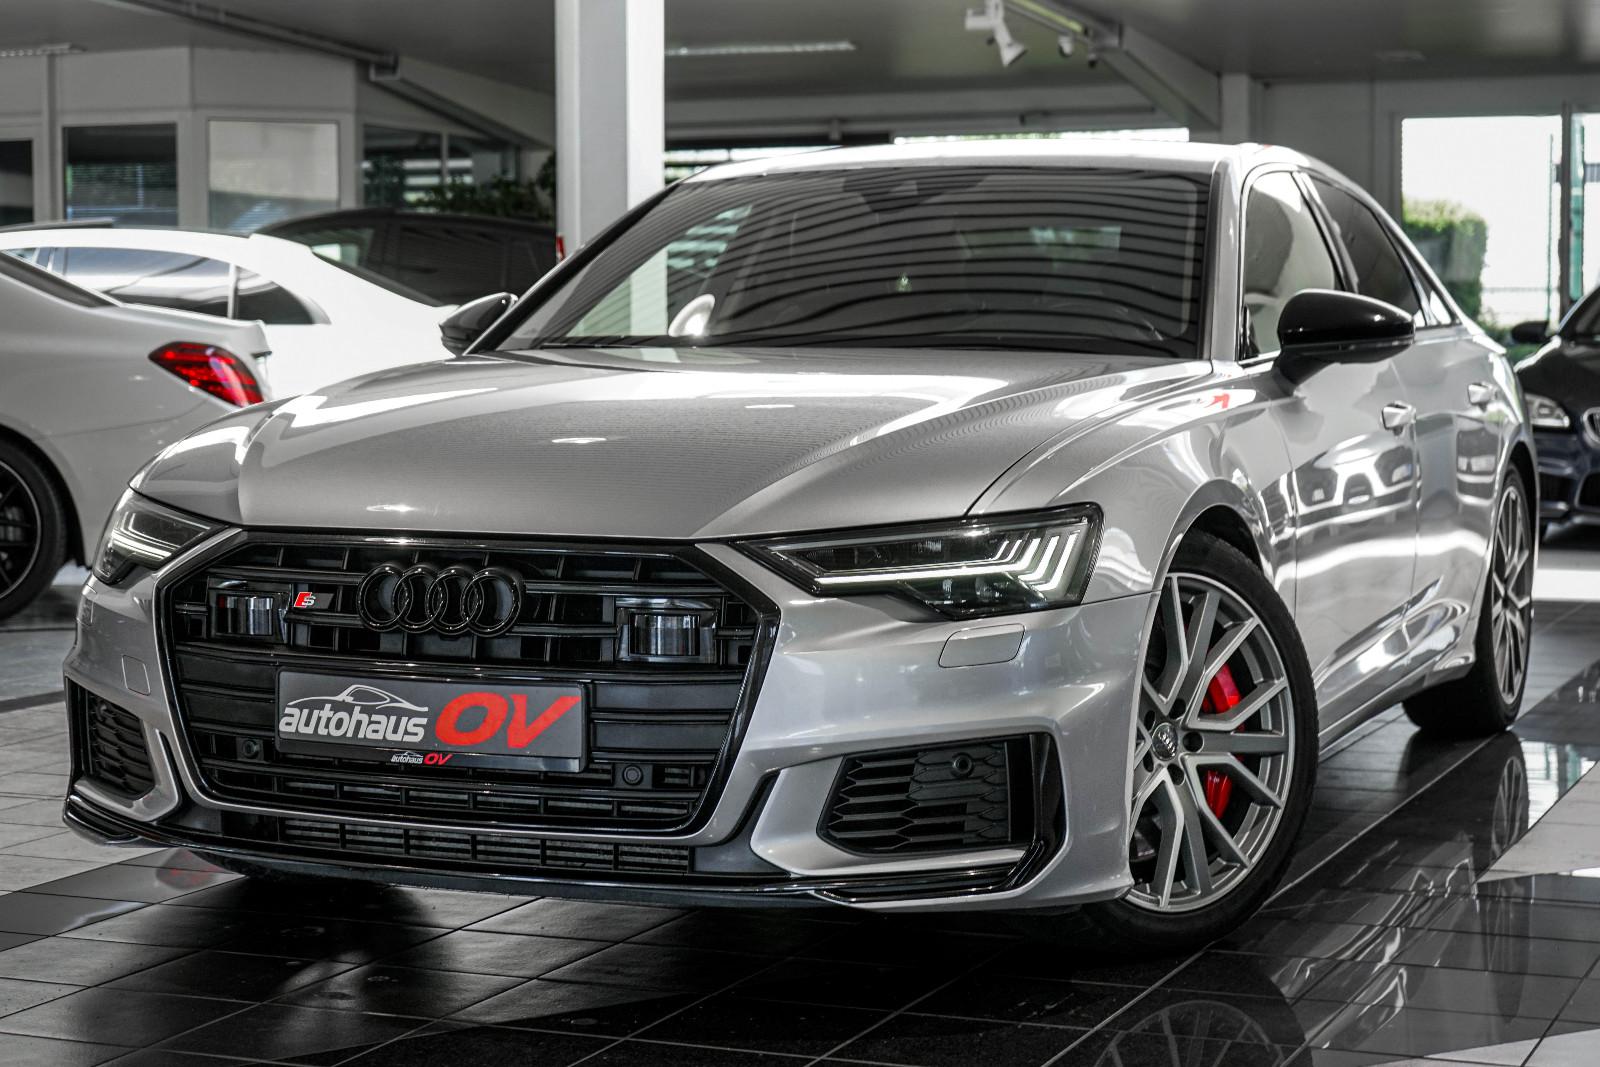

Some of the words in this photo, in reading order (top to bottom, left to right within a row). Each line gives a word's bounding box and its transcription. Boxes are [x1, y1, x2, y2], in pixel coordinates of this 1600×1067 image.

[299, 593, 317, 607] S
[278, 703, 429, 743] autohaus
[434, 692, 582, 749] OV
[390, 754, 424, 765] autohaus
[424, 752, 453, 766] OV
